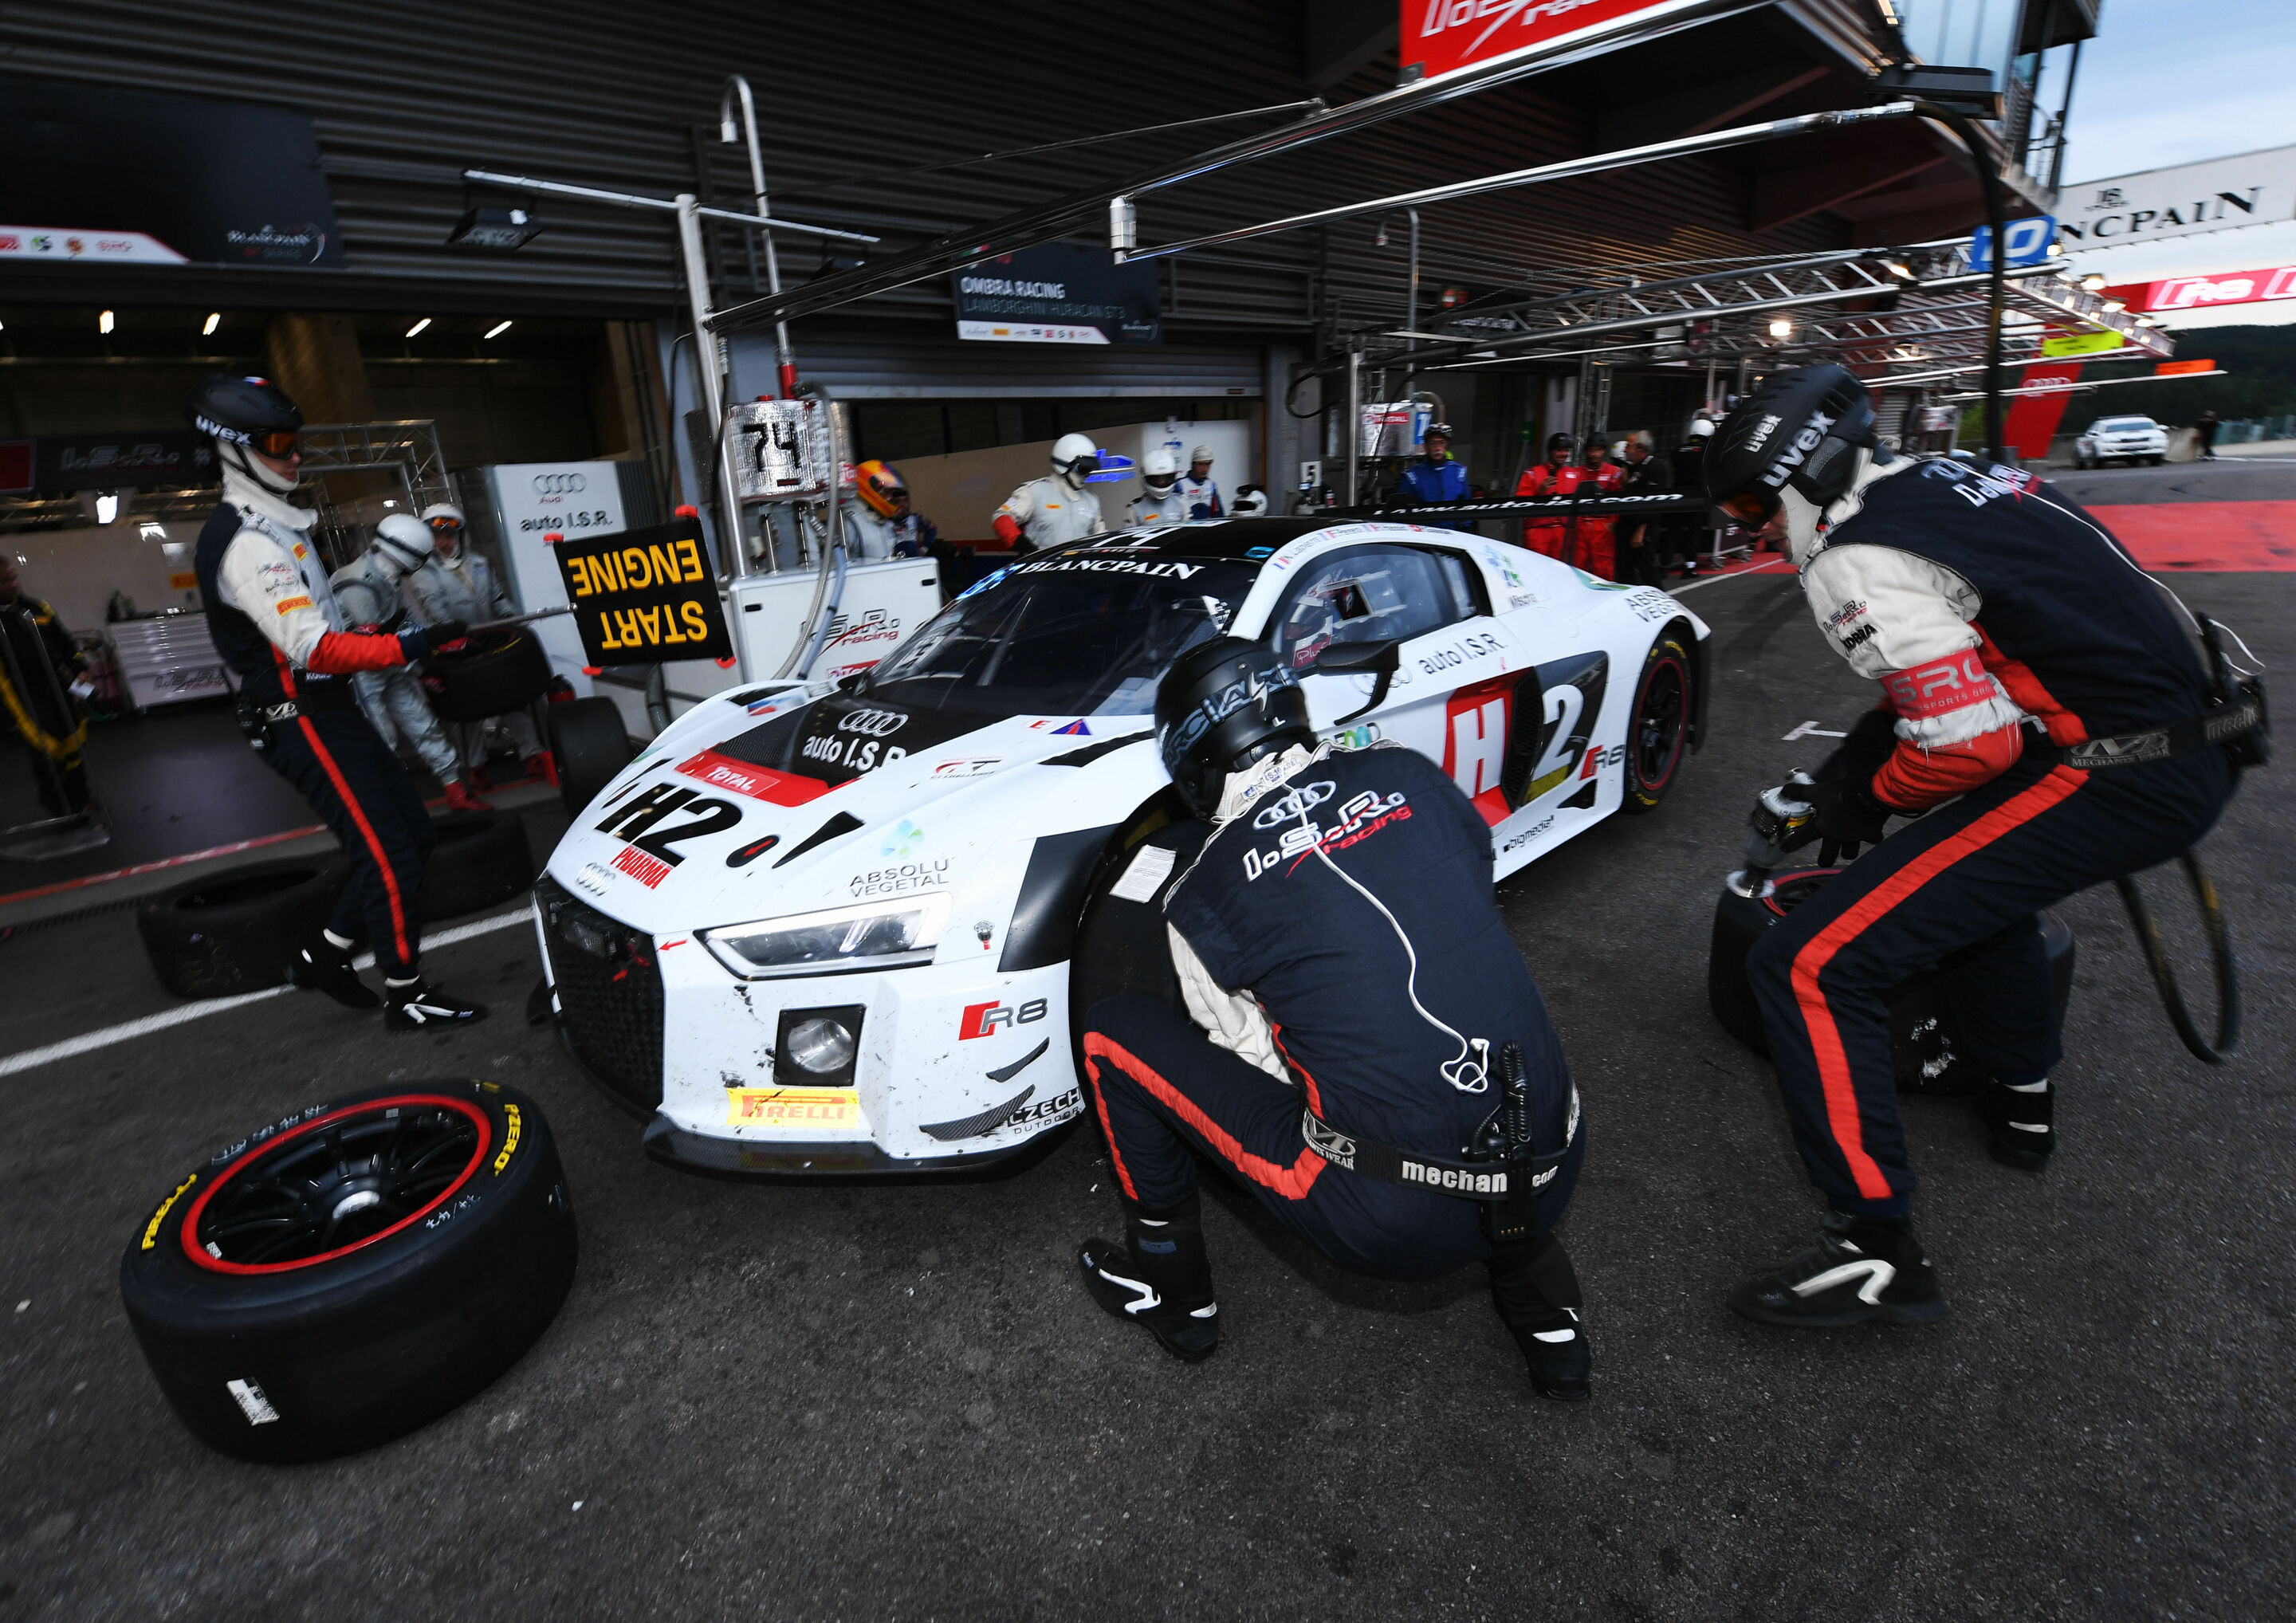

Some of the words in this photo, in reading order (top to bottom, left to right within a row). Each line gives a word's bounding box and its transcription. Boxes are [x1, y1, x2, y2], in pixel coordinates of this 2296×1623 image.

[2054, 186, 2265, 241] NCPAIN
[961, 276, 1014, 296] OMBRA
[1015, 281, 1066, 299] RACING
[196, 415, 251, 446] uvex
[1744, 414, 1783, 453] uvex
[742, 422, 800, 472] 74
[1762, 410, 1837, 487] uvex
[539, 495, 564, 505] Audi
[520, 514, 564, 532] auto
[566, 510, 613, 529] I.S.R.
[567, 539, 705, 598] ENGINE
[1016, 560, 1205, 580] BLANCPAIN
[600, 600, 708, 650] START
[841, 631, 899, 646] racing
[1418, 643, 1462, 675] auto
[1464, 633, 1508, 660] I.S.R.
[1028, 720, 1052, 729] E
[802, 734, 843, 763] auto
[706, 765, 757, 791] TOTAL
[594, 781, 743, 869] H2
[1322, 804, 1413, 855] racing
[610, 845, 673, 890] PHARMA
[850, 859, 949, 886] ABSOLU
[850, 874, 949, 898] VEGETAL
[979, 998, 1048, 1035] R8
[741, 1094, 847, 1120] PIRELLI
[1008, 1086, 1080, 1127] CZECH
[1014, 1106, 1081, 1134] OUTDOOR
[1326, 1153, 1354, 1170] WEAR
[142, 1173, 198, 1250] PIRELLI
